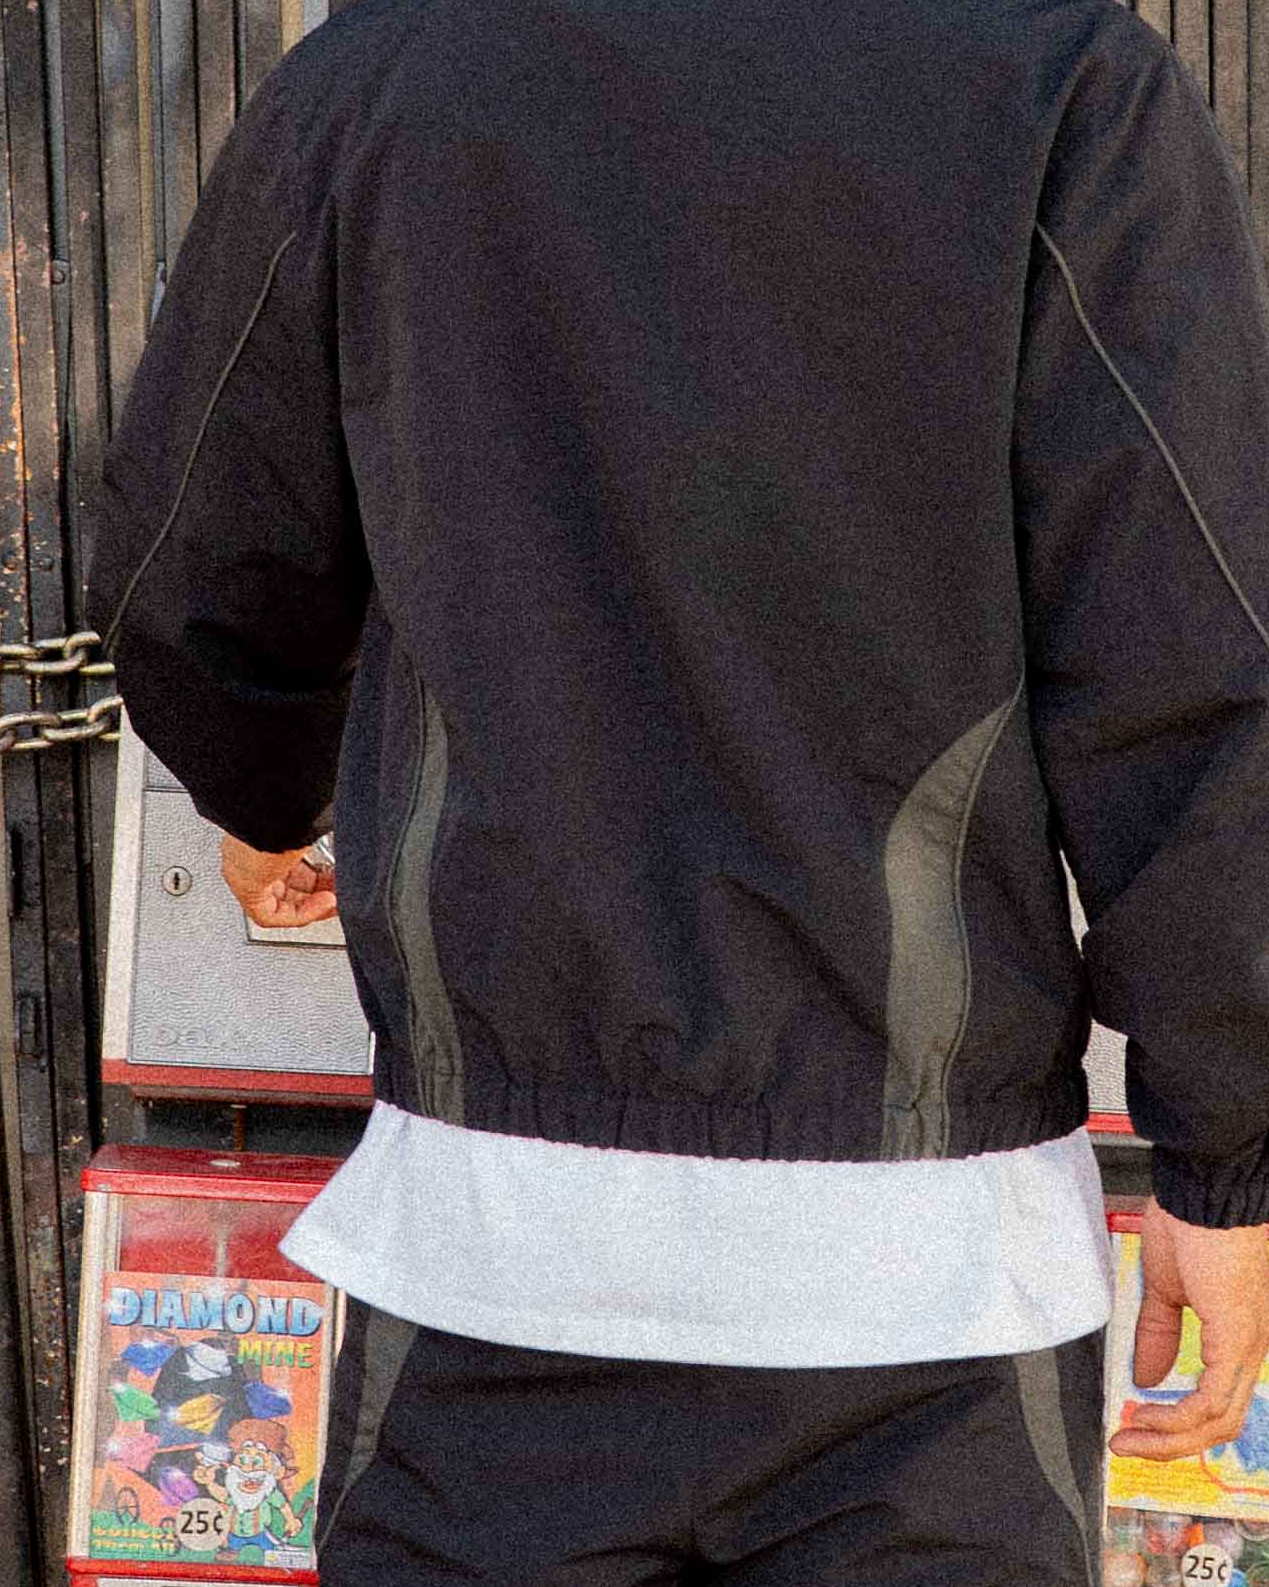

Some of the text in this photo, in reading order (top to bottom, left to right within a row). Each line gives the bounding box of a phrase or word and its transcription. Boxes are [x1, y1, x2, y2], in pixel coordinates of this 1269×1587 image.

[108, 1286, 322, 1336] DIAMOND
[237, 1338, 315, 1369] MINE
[181, 1510, 225, 1535] 25¢
[1185, 1555, 1227, 1582] 25¢
